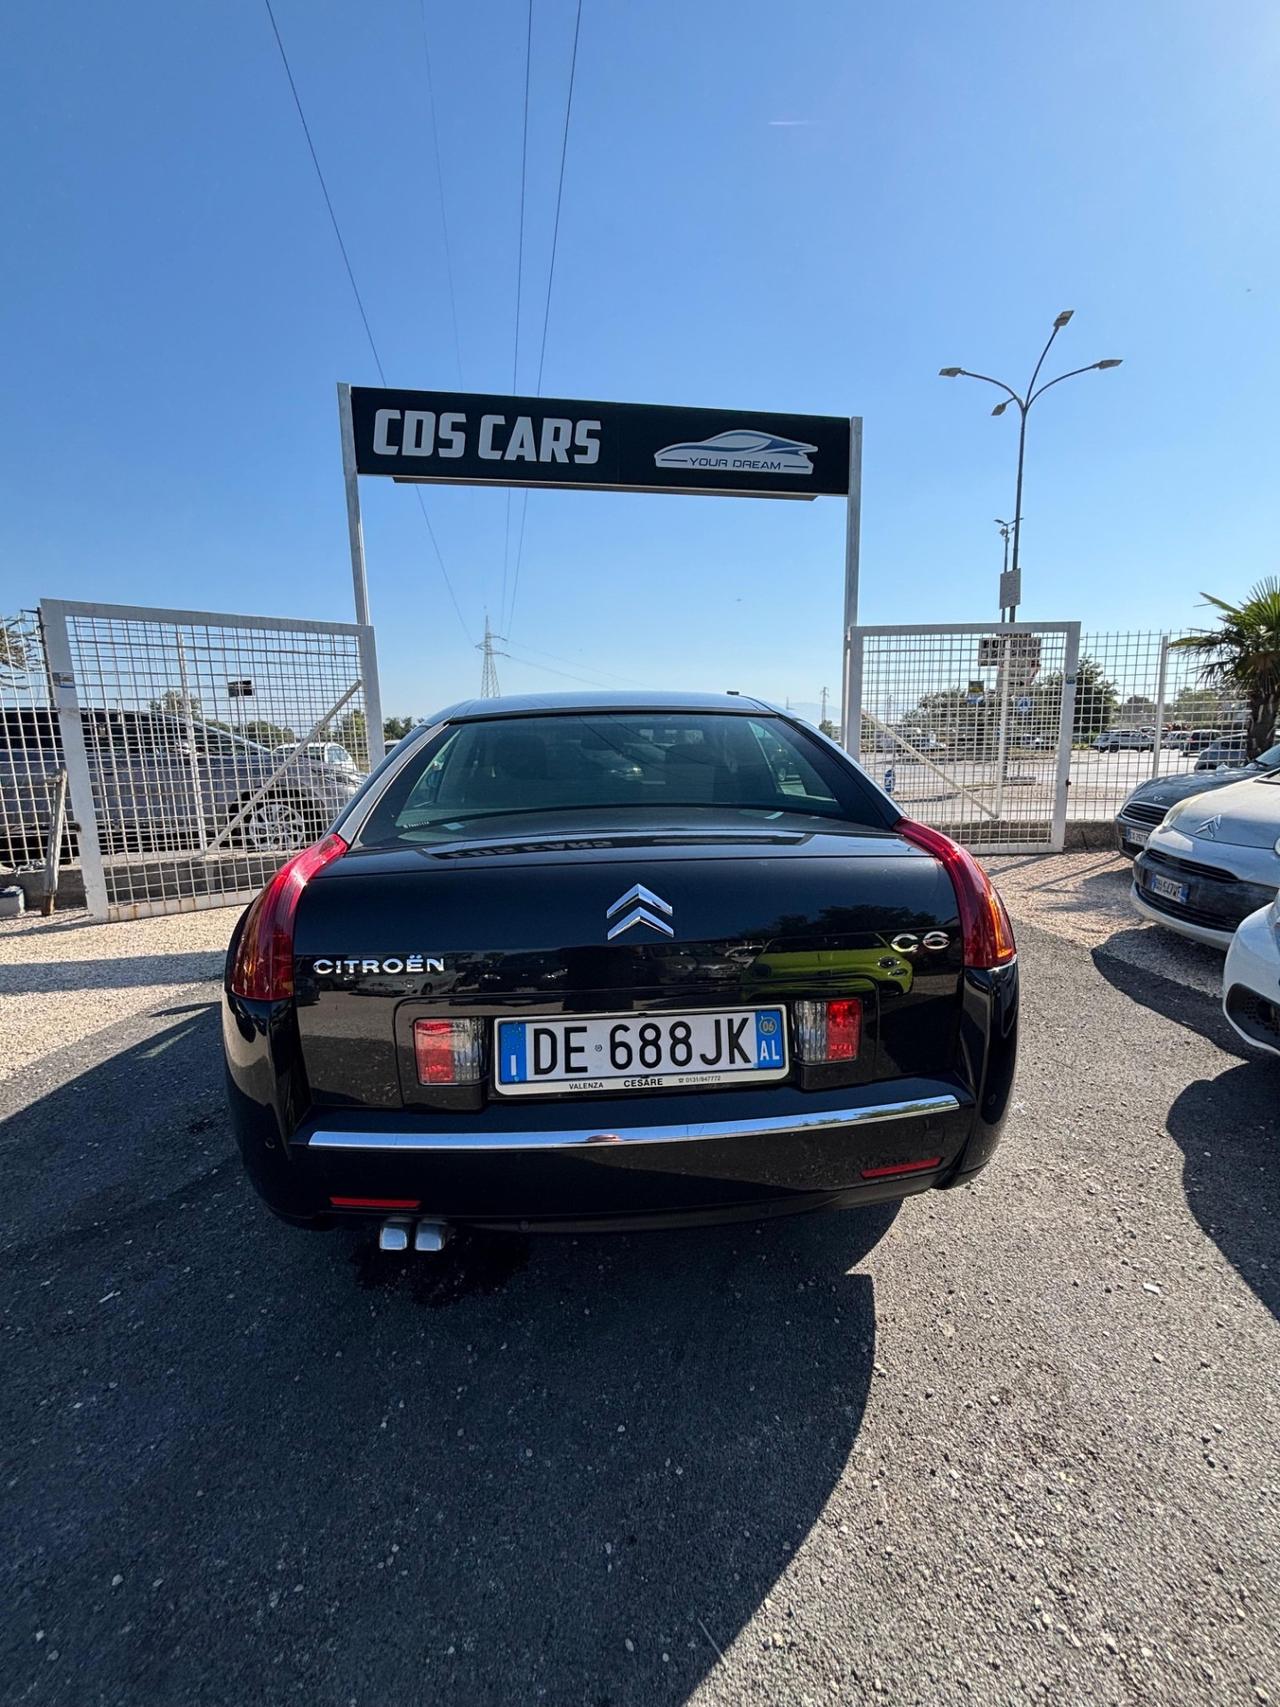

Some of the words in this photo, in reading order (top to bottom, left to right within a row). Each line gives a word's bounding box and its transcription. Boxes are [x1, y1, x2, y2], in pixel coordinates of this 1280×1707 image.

[373, 408, 467, 459] CDS
[478, 414, 602, 465] CARS
[689, 457, 728, 468] YOUR
[732, 459, 782, 471] DREAM
[891, 930, 950, 953] C6
[312, 954, 445, 975] CITROËN
[762, 1020, 775, 1032] 06
[533, 1026, 589, 1076] DE
[760, 1039, 780, 1061] AL
[510, 1054, 517, 1076] I
[568, 1081, 604, 1091] VALENZA
[623, 1077, 664, 1088] CESARE
